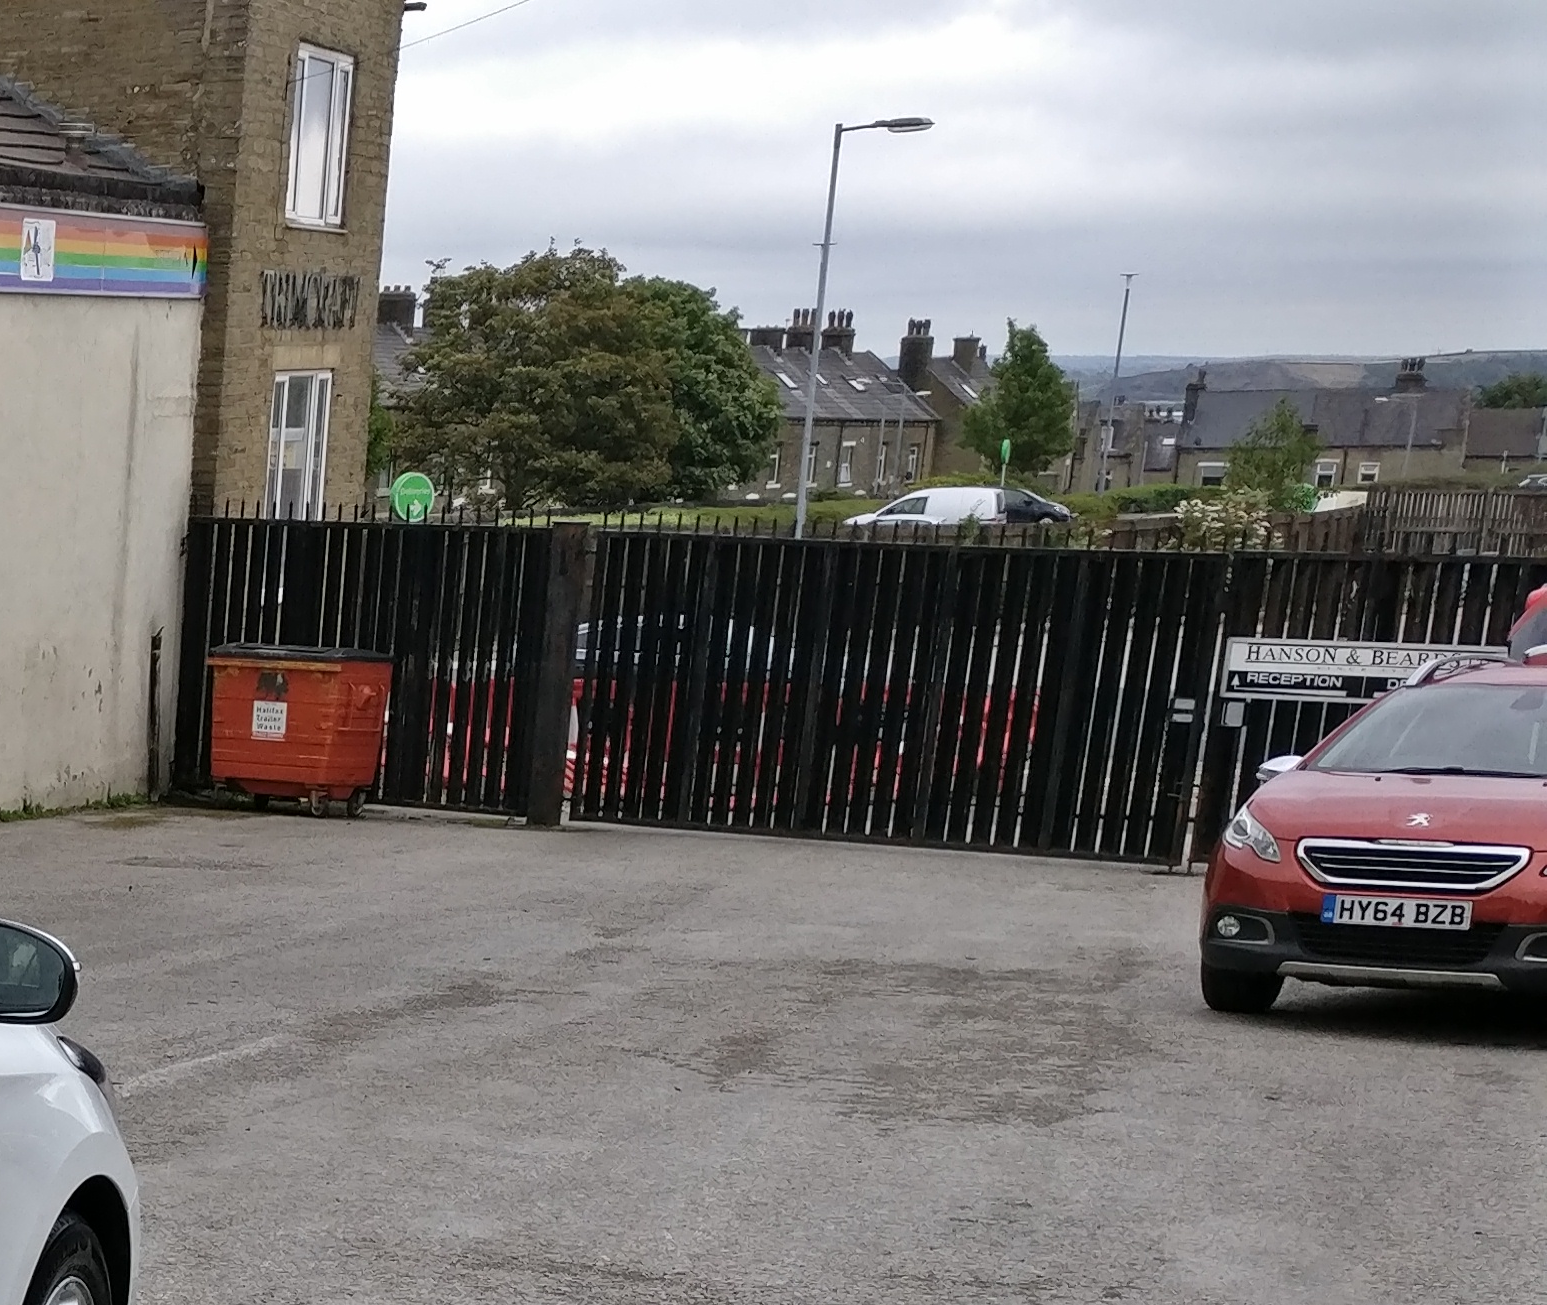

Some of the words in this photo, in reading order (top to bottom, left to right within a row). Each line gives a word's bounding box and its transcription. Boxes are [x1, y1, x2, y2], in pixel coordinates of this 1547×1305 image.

[1246, 644, 1339, 664] HANSON
[1345, 648, 1362, 665] &
[1247, 672, 1343, 688] RECEPTION
[1338, 899, 1405, 923] HY64
[1413, 903, 1466, 926] BZB
